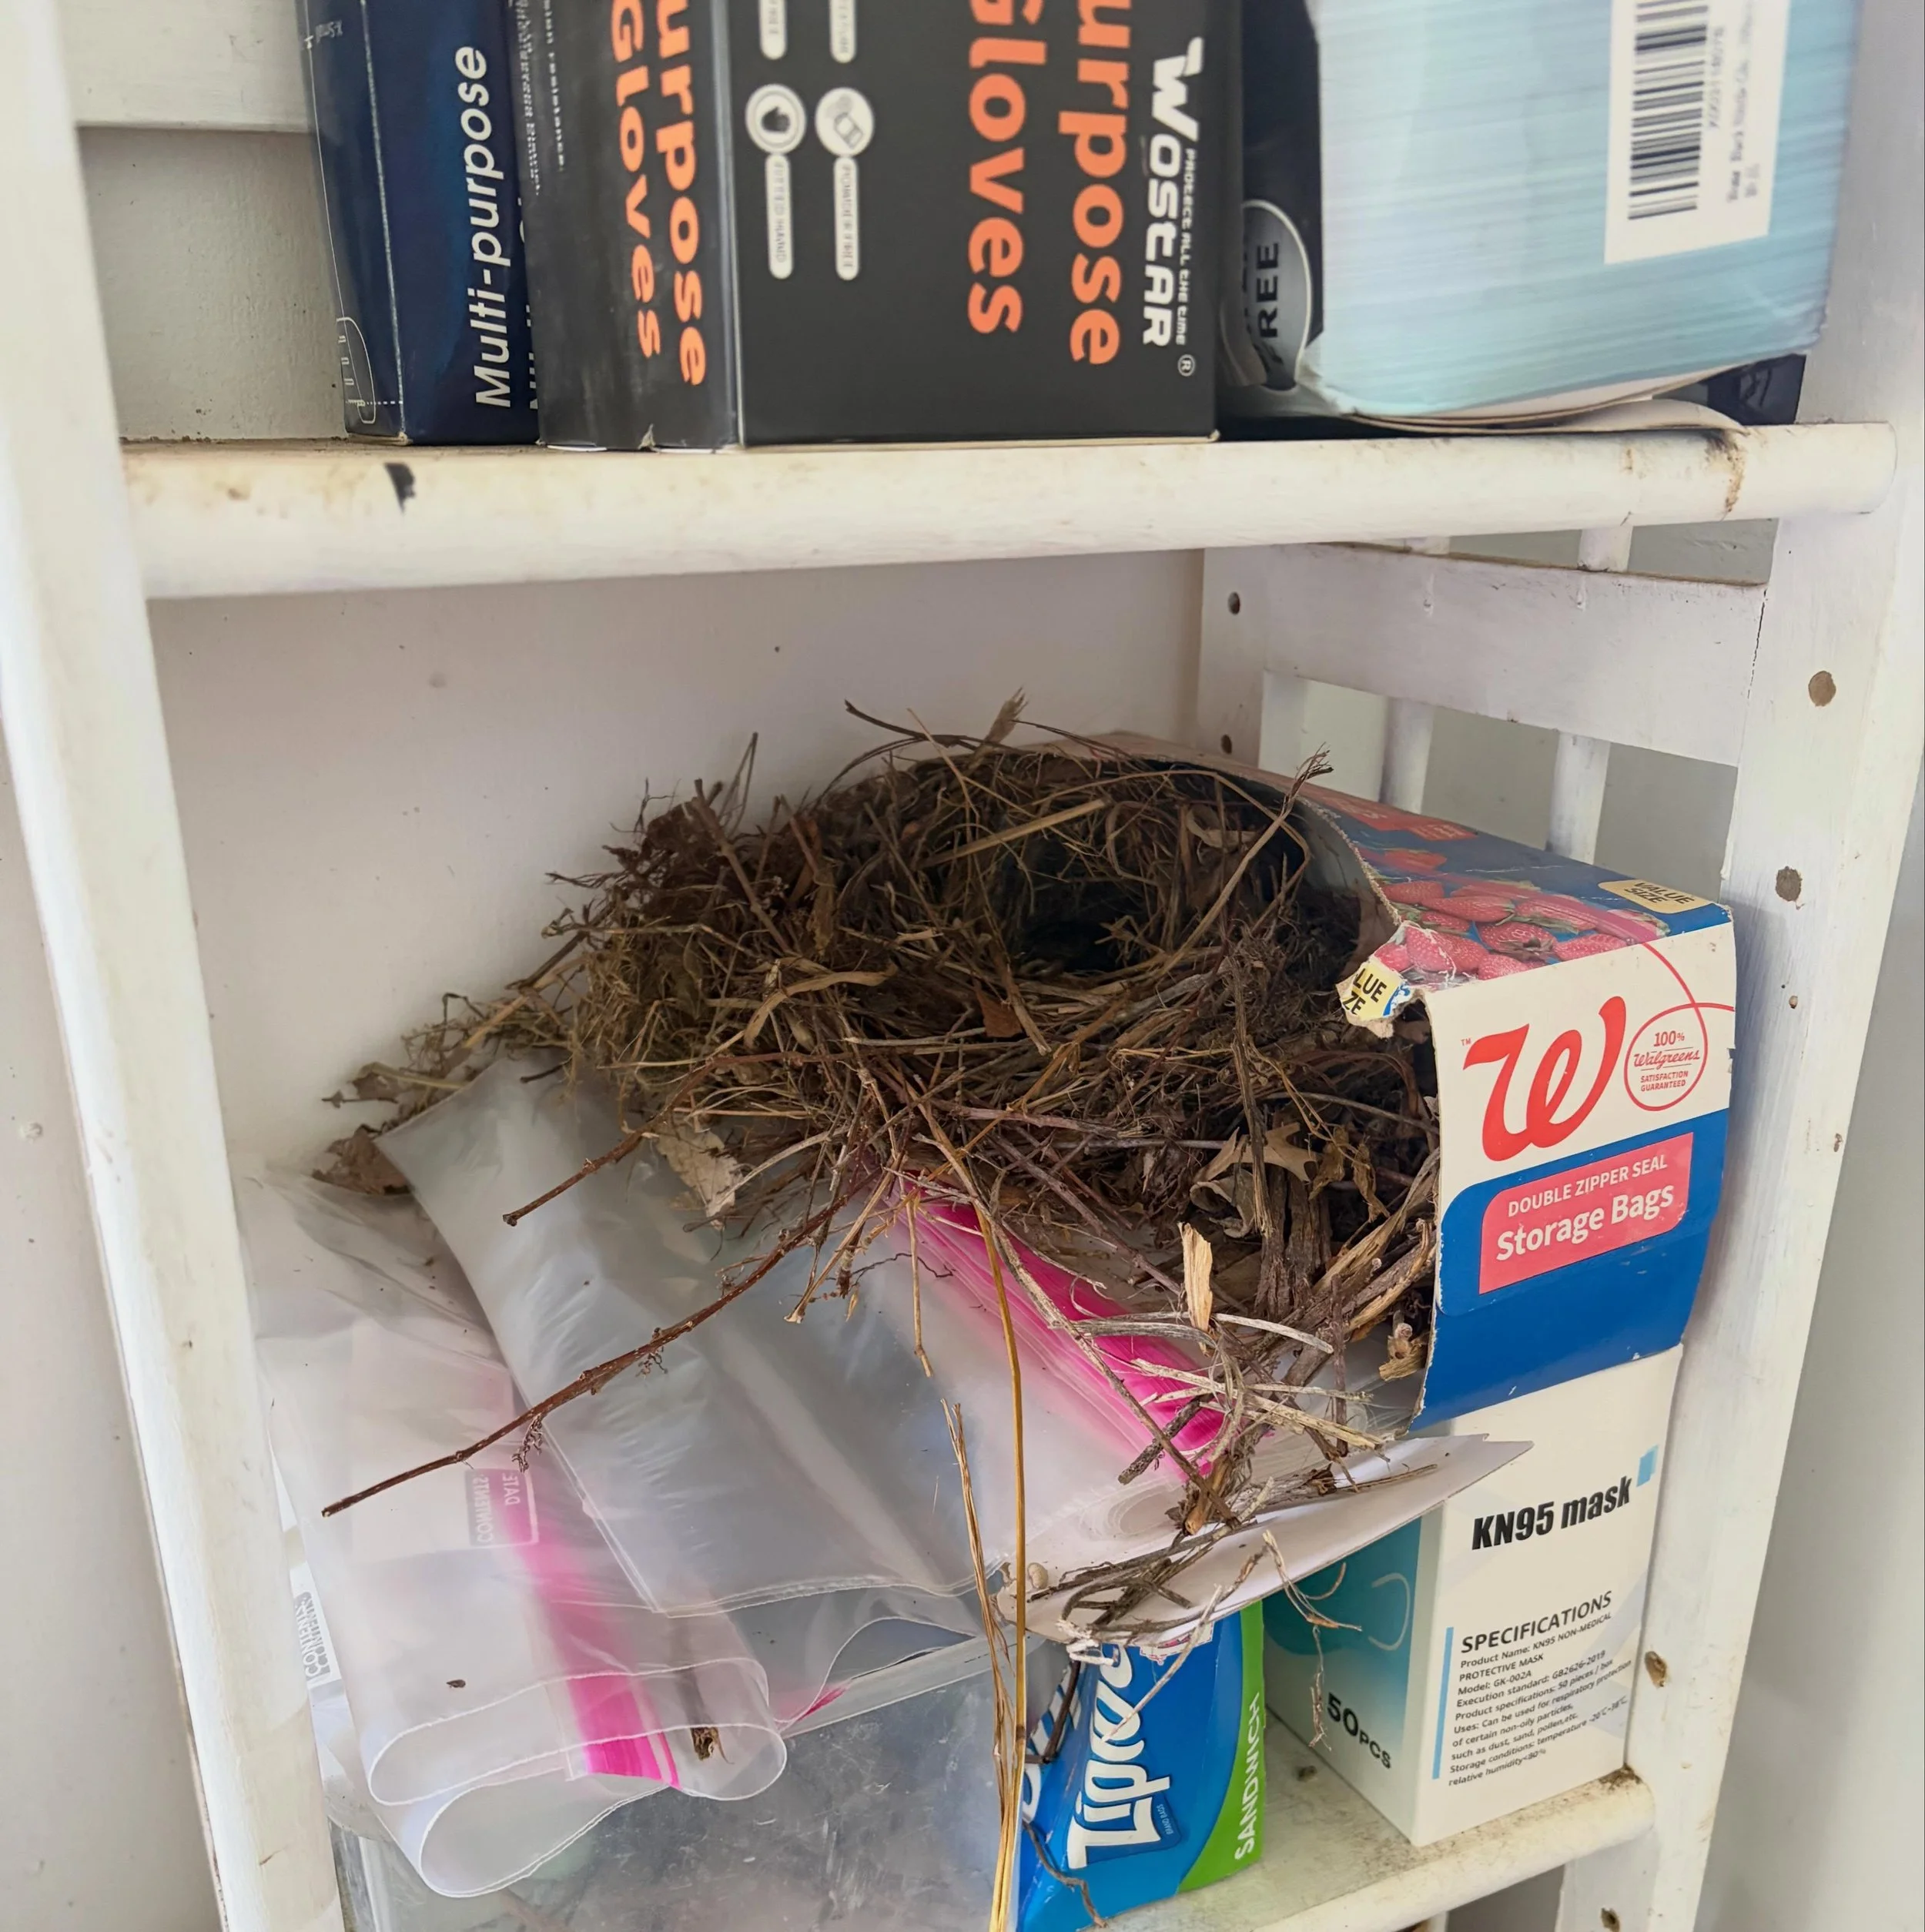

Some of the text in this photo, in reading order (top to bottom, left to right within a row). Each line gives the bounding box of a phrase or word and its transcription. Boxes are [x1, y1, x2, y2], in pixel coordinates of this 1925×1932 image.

[611, 0, 661, 358] Gloves
[656, 0, 705, 385] urpose
[1058, 0, 1131, 365] urpose
[456, 46, 511, 408] Multi-purpose
[1624, 887, 1669, 903] SIZE
[1634, 882, 1695, 904] VALUE
[1633, 1050, 1700, 1070] Walgreens
[1654, 1030, 1685, 1047] 100%
[1640, 1070, 1689, 1083] SATISFACTION
[1641, 1080, 1686, 1092] GUARANTEED
[1508, 1154, 1668, 1217] DOUBLE ZIPPER SEAL
[1495, 1184, 1675, 1261] Storage Bags
[1471, 1475, 1632, 1550] KN95 mask
[1460, 1612, 1612, 1669] Product Name: KN95 NON-MEDICAL
[1461, 1590, 1612, 1654] SPECIFICATIONS
[1455, 1706, 1493, 1721] Product
[1495, 1686, 1555, 1713] specifications:
[1558, 1679, 1568, 1690] 50
[1569, 1669, 1594, 1687] pieces
[1601, 1659, 1613, 1670] box
[1456, 1649, 1606, 1707] Execution standard: GB2626-2019
[1458, 1669, 1532, 1696] Model: GK-002A
[1459, 1652, 1544, 1682] PROTECTIVE MASK
[1452, 1703, 1573, 1748] of certain non-oily particles,
[1454, 1660, 1632, 1734] Uses: Can be used for respiratory protection
[1450, 1759, 1486, 1773] Storage
[1488, 1741, 1535, 1763] conditions:
[1537, 1720, 1588, 1746] temperature
[1451, 1749, 1473, 1760] such
[1475, 1746, 1486, 1755] as
[1488, 1738, 1510, 1751] dust,
[1513, 1729, 1535, 1743] sand,
[1234, 1693, 1260, 1860] SANDWICH
[1448, 1772, 1484, 1786] relative
